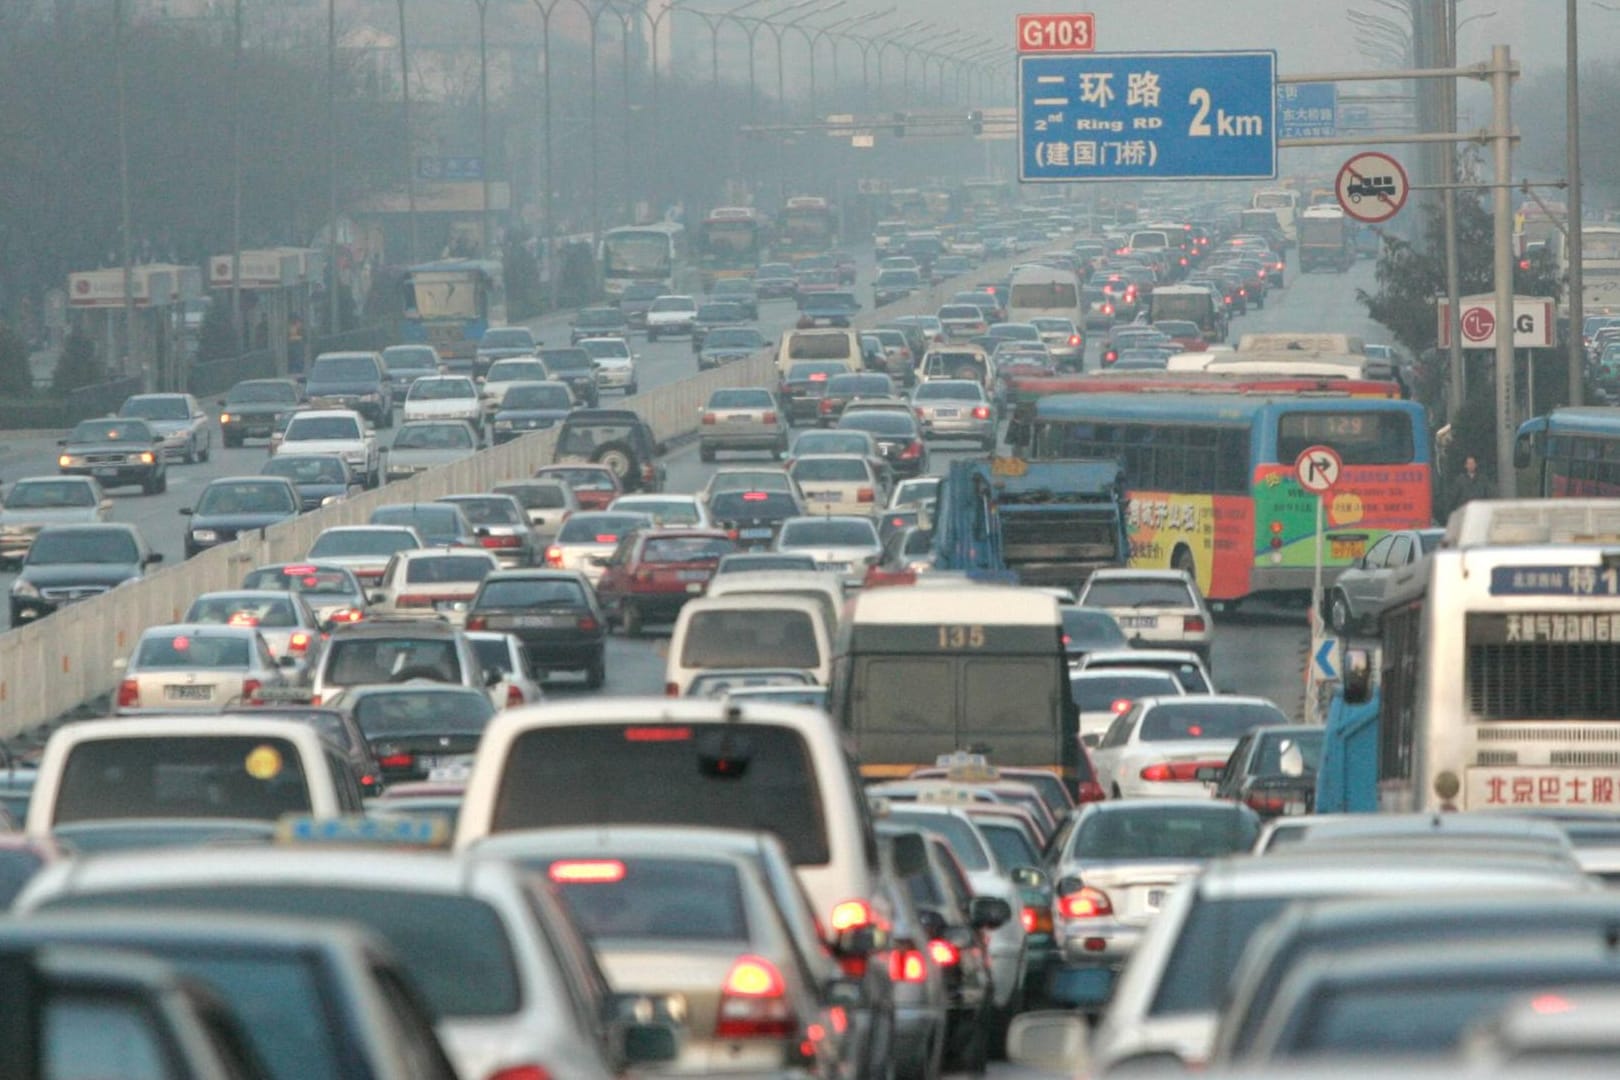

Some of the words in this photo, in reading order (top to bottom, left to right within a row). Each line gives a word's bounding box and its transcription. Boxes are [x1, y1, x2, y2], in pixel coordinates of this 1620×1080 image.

[1023, 20, 1089, 46] G103
[1034, 71, 1162, 108] 二环路
[1077, 118, 1124, 132] Ring
[1133, 117, 1163, 129] RD
[1035, 140, 1158, 168] (建国门桥)
[938, 623, 985, 649] 135
[1485, 776, 1620, 805] 北京巴士股
